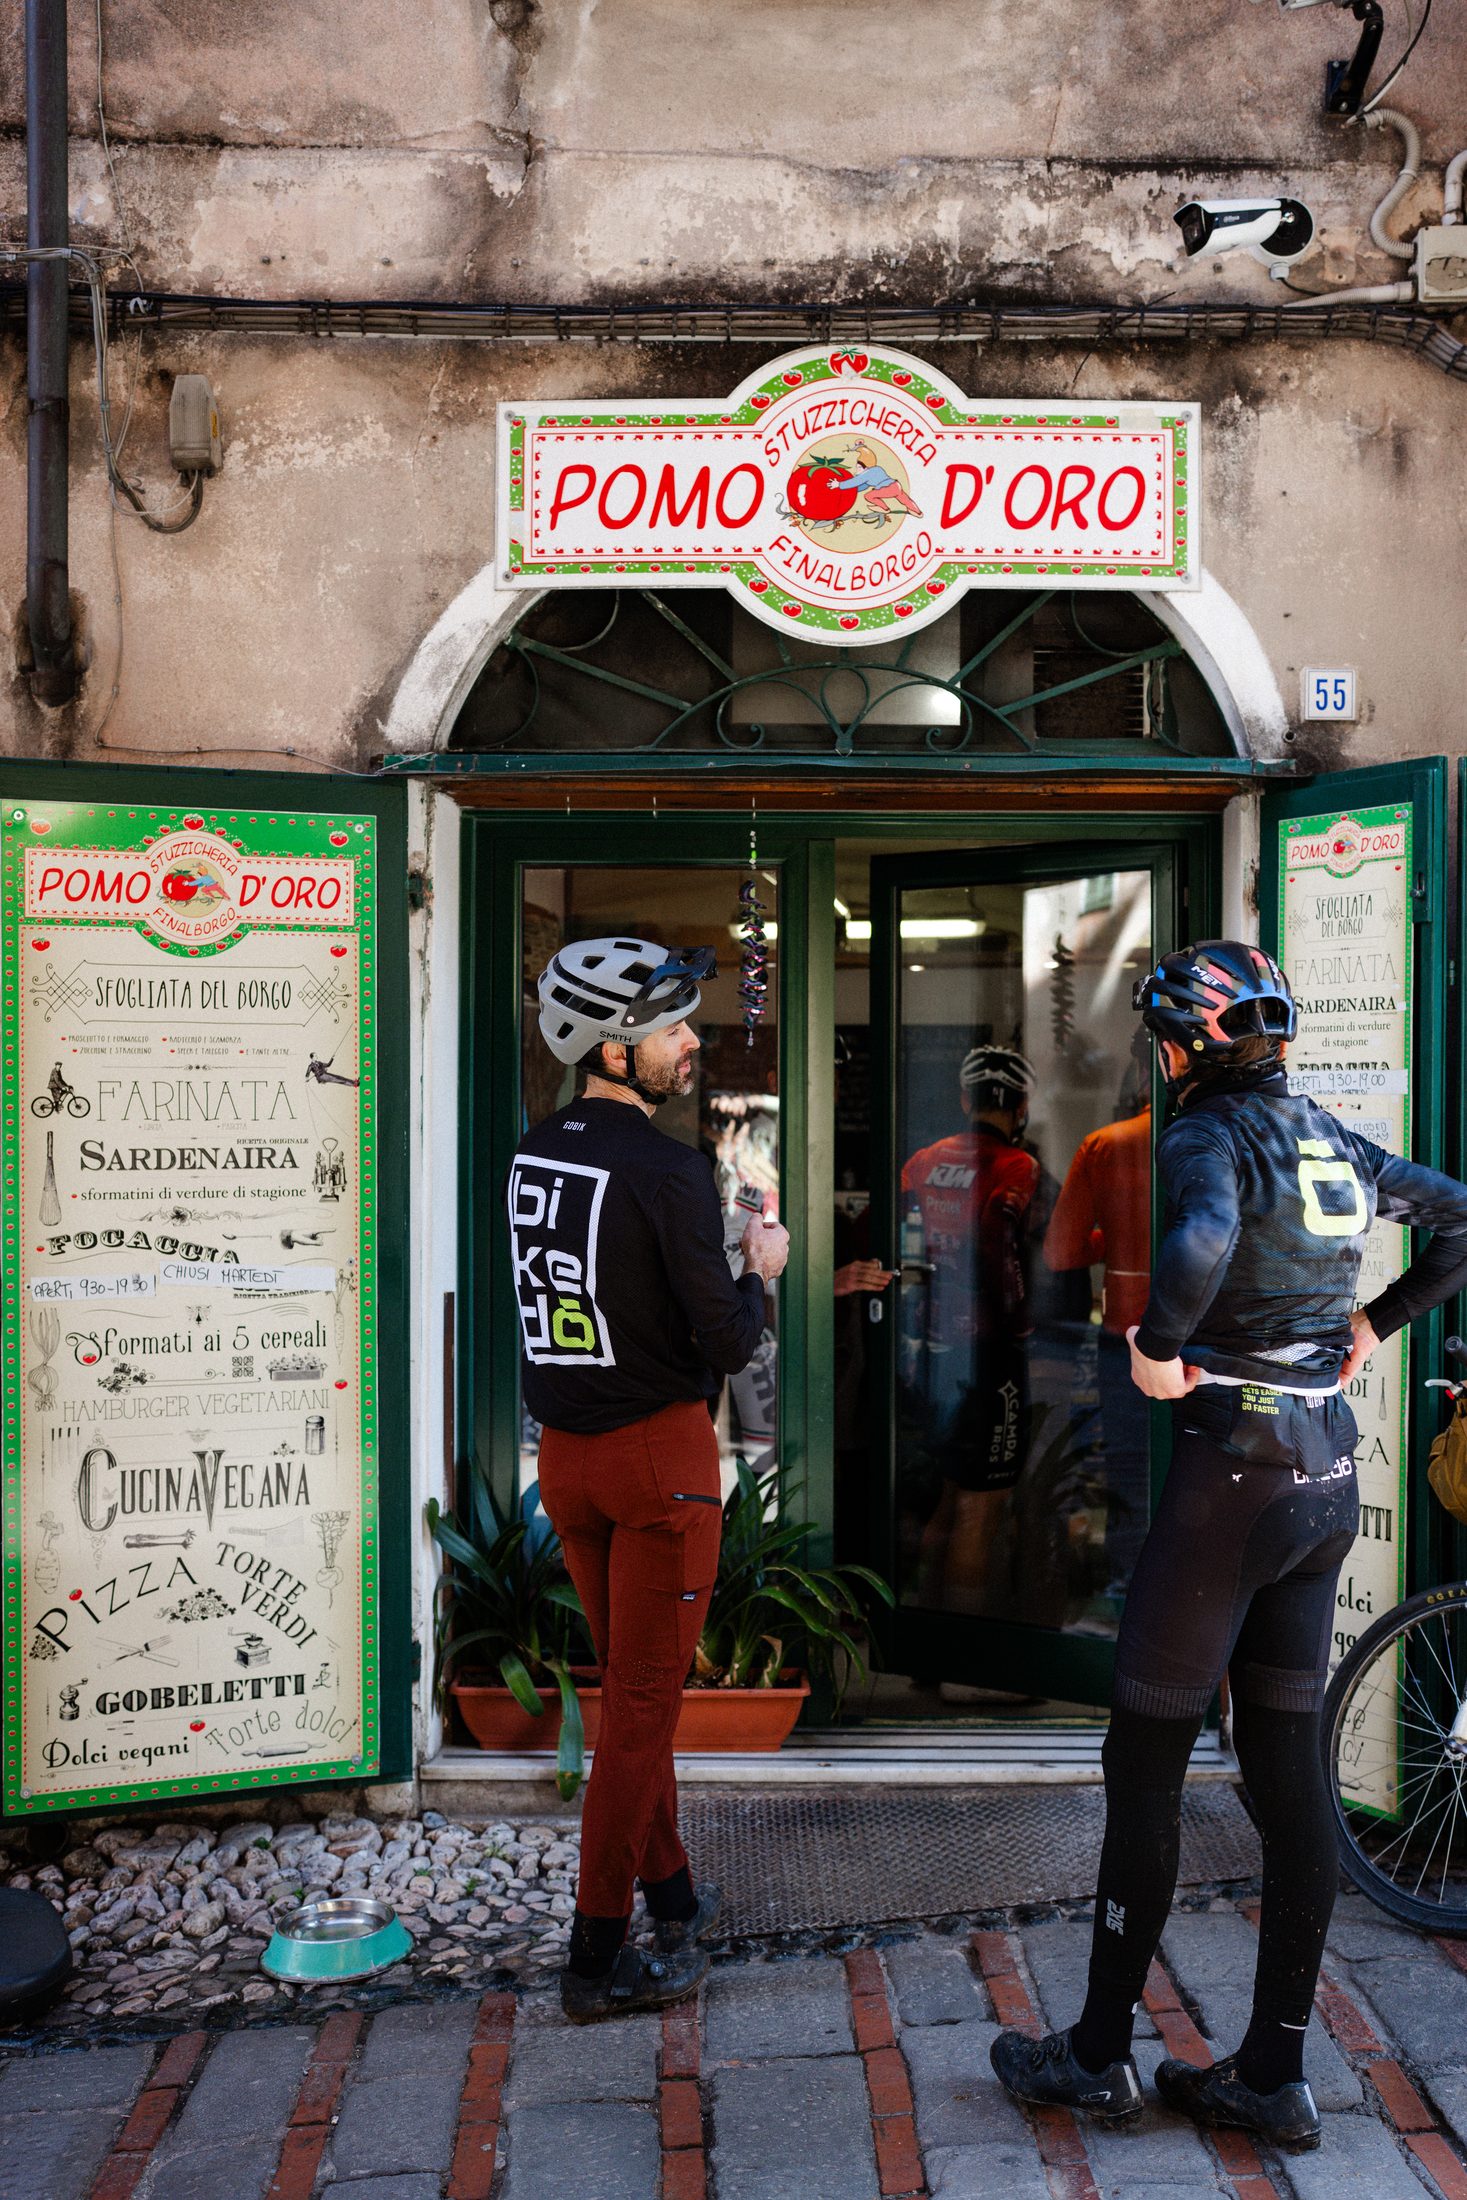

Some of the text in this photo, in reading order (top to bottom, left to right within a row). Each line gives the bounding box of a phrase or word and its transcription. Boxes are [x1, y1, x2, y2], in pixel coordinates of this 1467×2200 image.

[764, 399, 938, 468] STUZZICHERIA
[549, 464, 1146, 531] POMO D'ORO
[769, 531, 932, 592] FINALBORGO
[1316, 679, 1346, 711] 55
[150, 842, 238, 877] STUZZICHERIA
[1291, 842, 1329, 861] POMO
[39, 868, 342, 909] POMO D'ORO
[153, 908, 237, 936] FINALBORGO
[1315, 894, 1373, 920] SFOGLIATA
[1321, 918, 1363, 938] DEL BORGO
[1190, 965, 1222, 986] MET
[1294, 953, 1397, 986] FARINATA
[95, 977, 292, 1010] SFOGLIATA DEL BORGO
[1294, 996, 1397, 1015] SARDENAIRA
[599, 1031, 632, 1043] SMITH
[1301, 1020, 1391, 1034] sformatini di verdure
[1321, 1037, 1369, 1050] di stagione
[97, 1080, 298, 1121] FARINATA
[236, 1137, 309, 1145] RICETTA ORIGINALE
[563, 1121, 587, 1132] GOBIK
[80, 1140, 300, 1171] SARDENAIRA
[925, 1163, 977, 1189] KTM
[81, 1184, 307, 1202] sformatini di verdure di stagione
[46, 1229, 240, 1265] FOCACCIA
[163, 1264, 210, 1281] CHIUSI
[65, 1320, 328, 1367] Sformati ai 5 cereali
[63, 1389, 330, 1423] HAMBURGER VEGETARIANI
[1241, 1394, 1275, 1405] YOU JUST
[1241, 1402, 1280, 1415] GO FASTER
[215, 1542, 308, 1606] TORTE
[1337, 1577, 1373, 1614] olci
[240, 1581, 318, 1650] VERDI
[95, 1674, 307, 1716] GOBELETTI
[205, 1700, 358, 1755] Torte dolci
[42, 1737, 190, 1769] Dolci vegani
